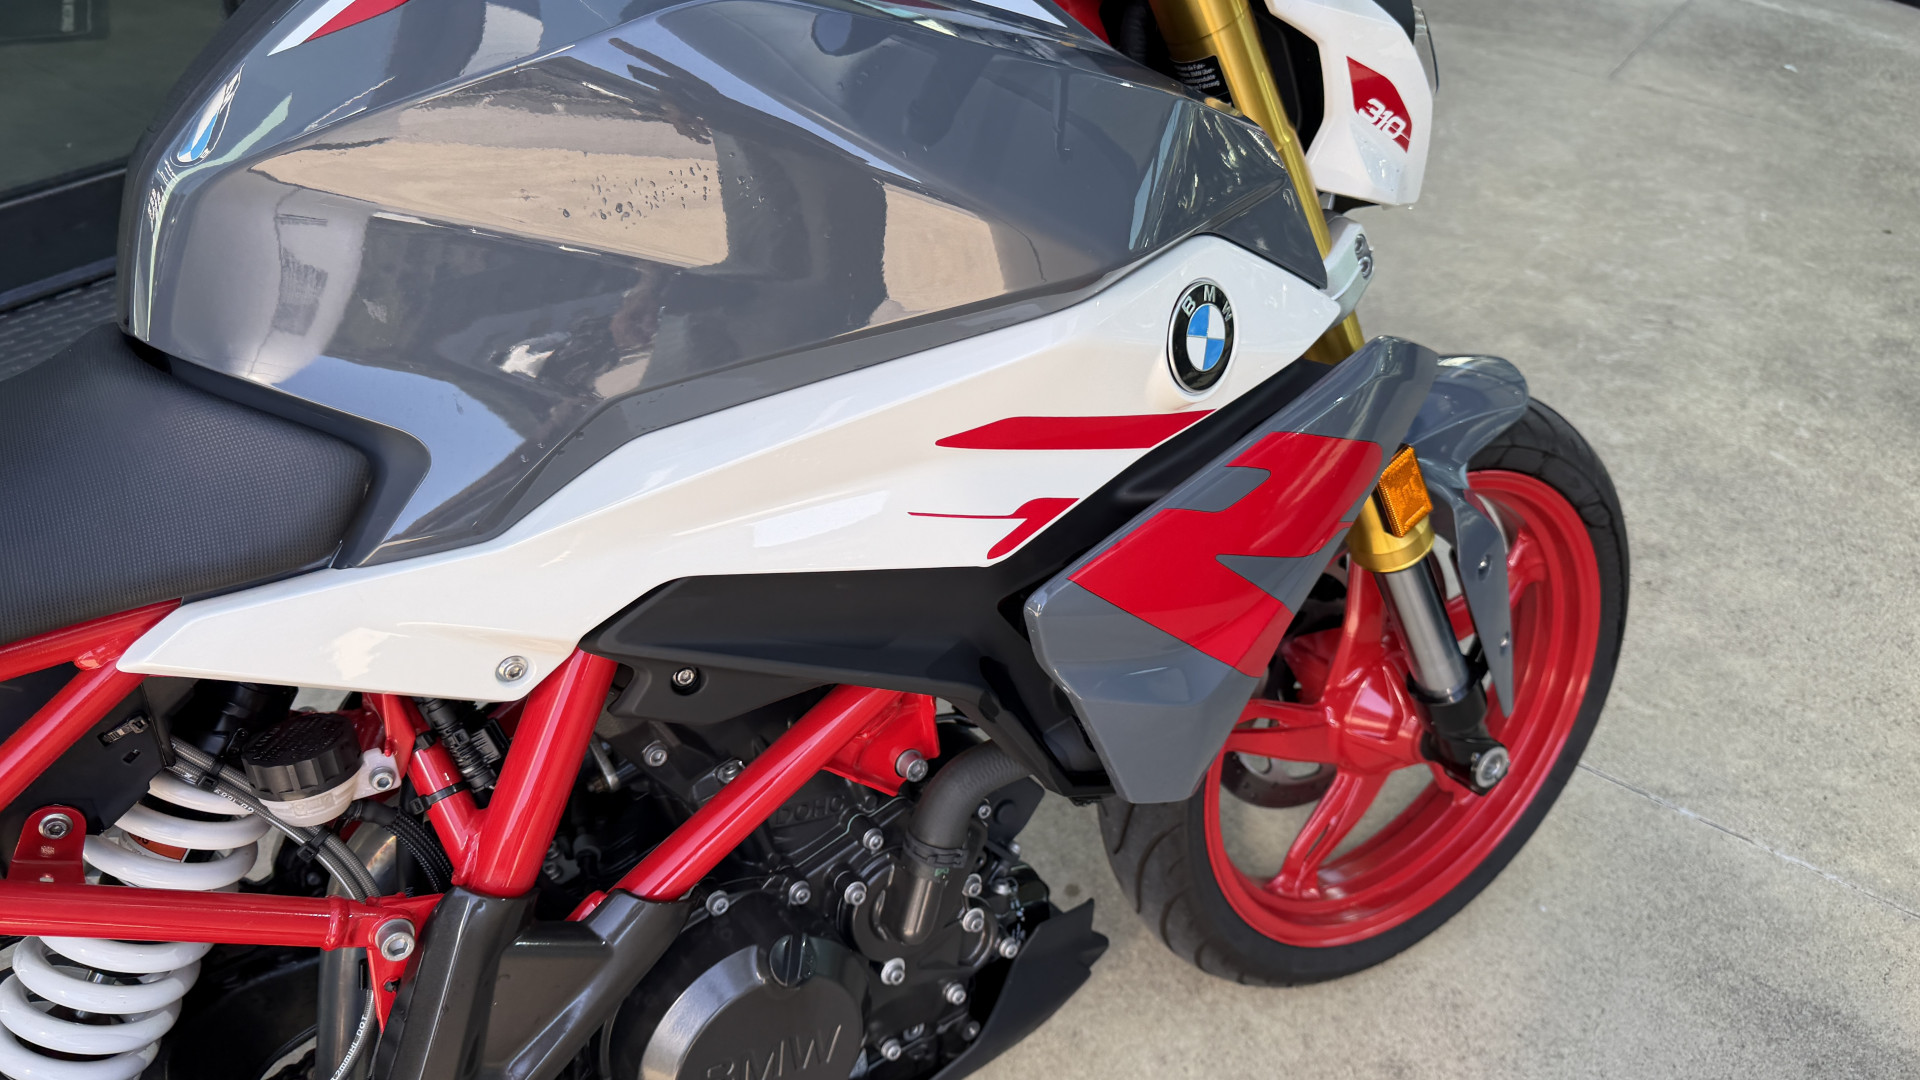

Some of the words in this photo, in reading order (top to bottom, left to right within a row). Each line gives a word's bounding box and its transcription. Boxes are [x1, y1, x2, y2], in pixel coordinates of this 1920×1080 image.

[1358, 98, 1407, 140] 310
[1181, 284, 1233, 322] BMW
[776, 795, 845, 825] DOHC
[356, 1014, 369, 1037] DOT
